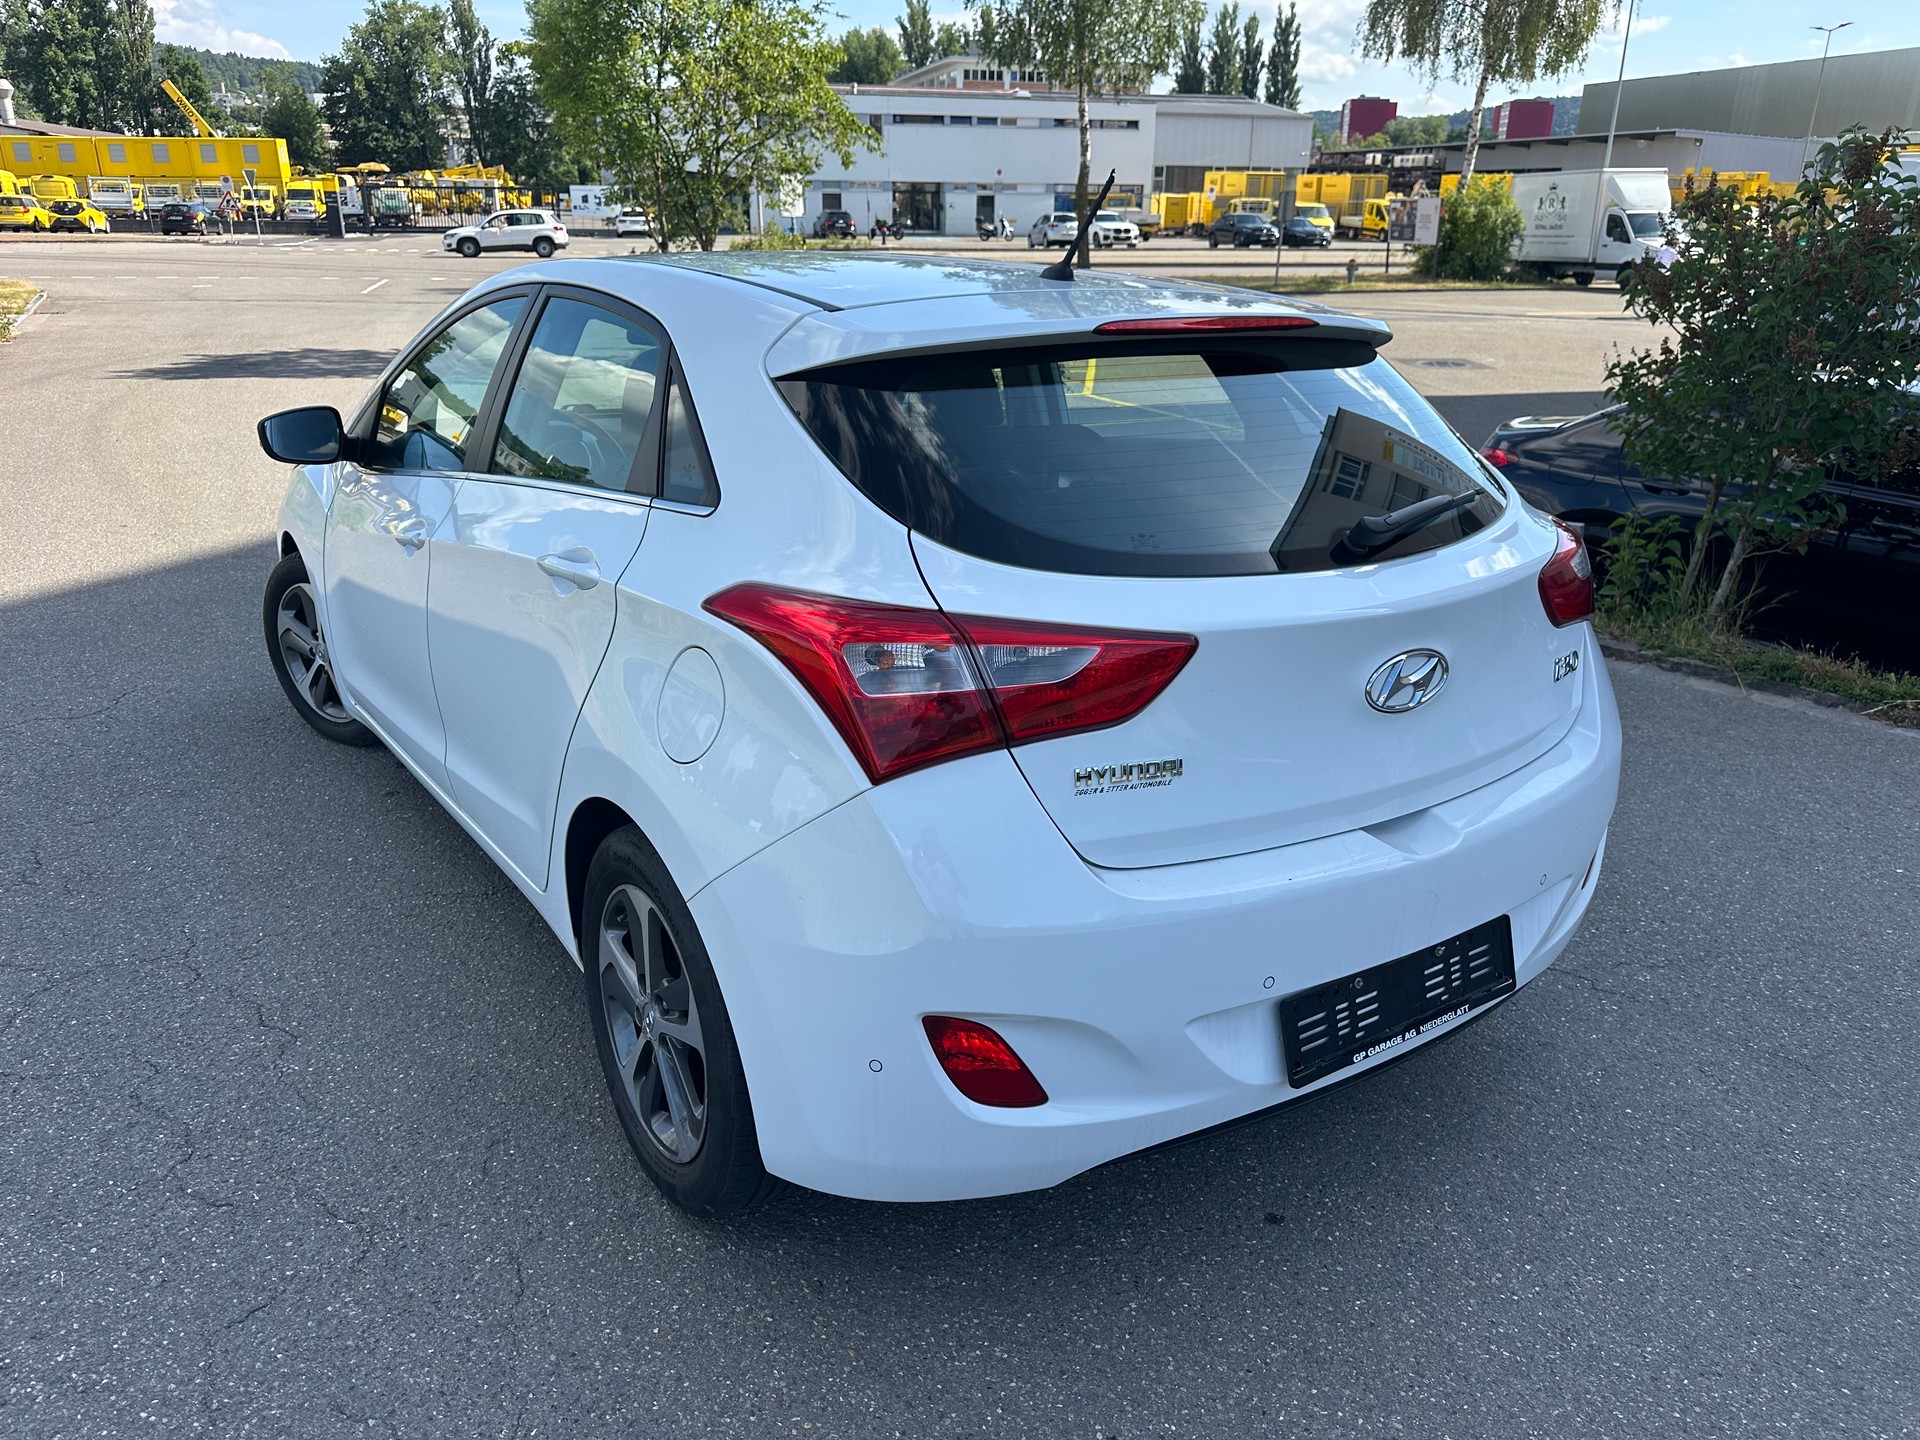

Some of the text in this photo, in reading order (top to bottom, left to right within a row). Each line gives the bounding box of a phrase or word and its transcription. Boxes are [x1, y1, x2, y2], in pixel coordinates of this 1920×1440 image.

[176, 97, 194, 118] WALO
[1553, 650, 1579, 682] i30
[1074, 758, 1183, 788] HYUNDAI
[1074, 787, 1099, 797] EGGER
[1106, 784, 1129, 793] ETTER
[1129, 779, 1174, 790] AUTOMOBILE
[1353, 1004, 1470, 1063] GP GARAGE AG NIEDERGLATT
